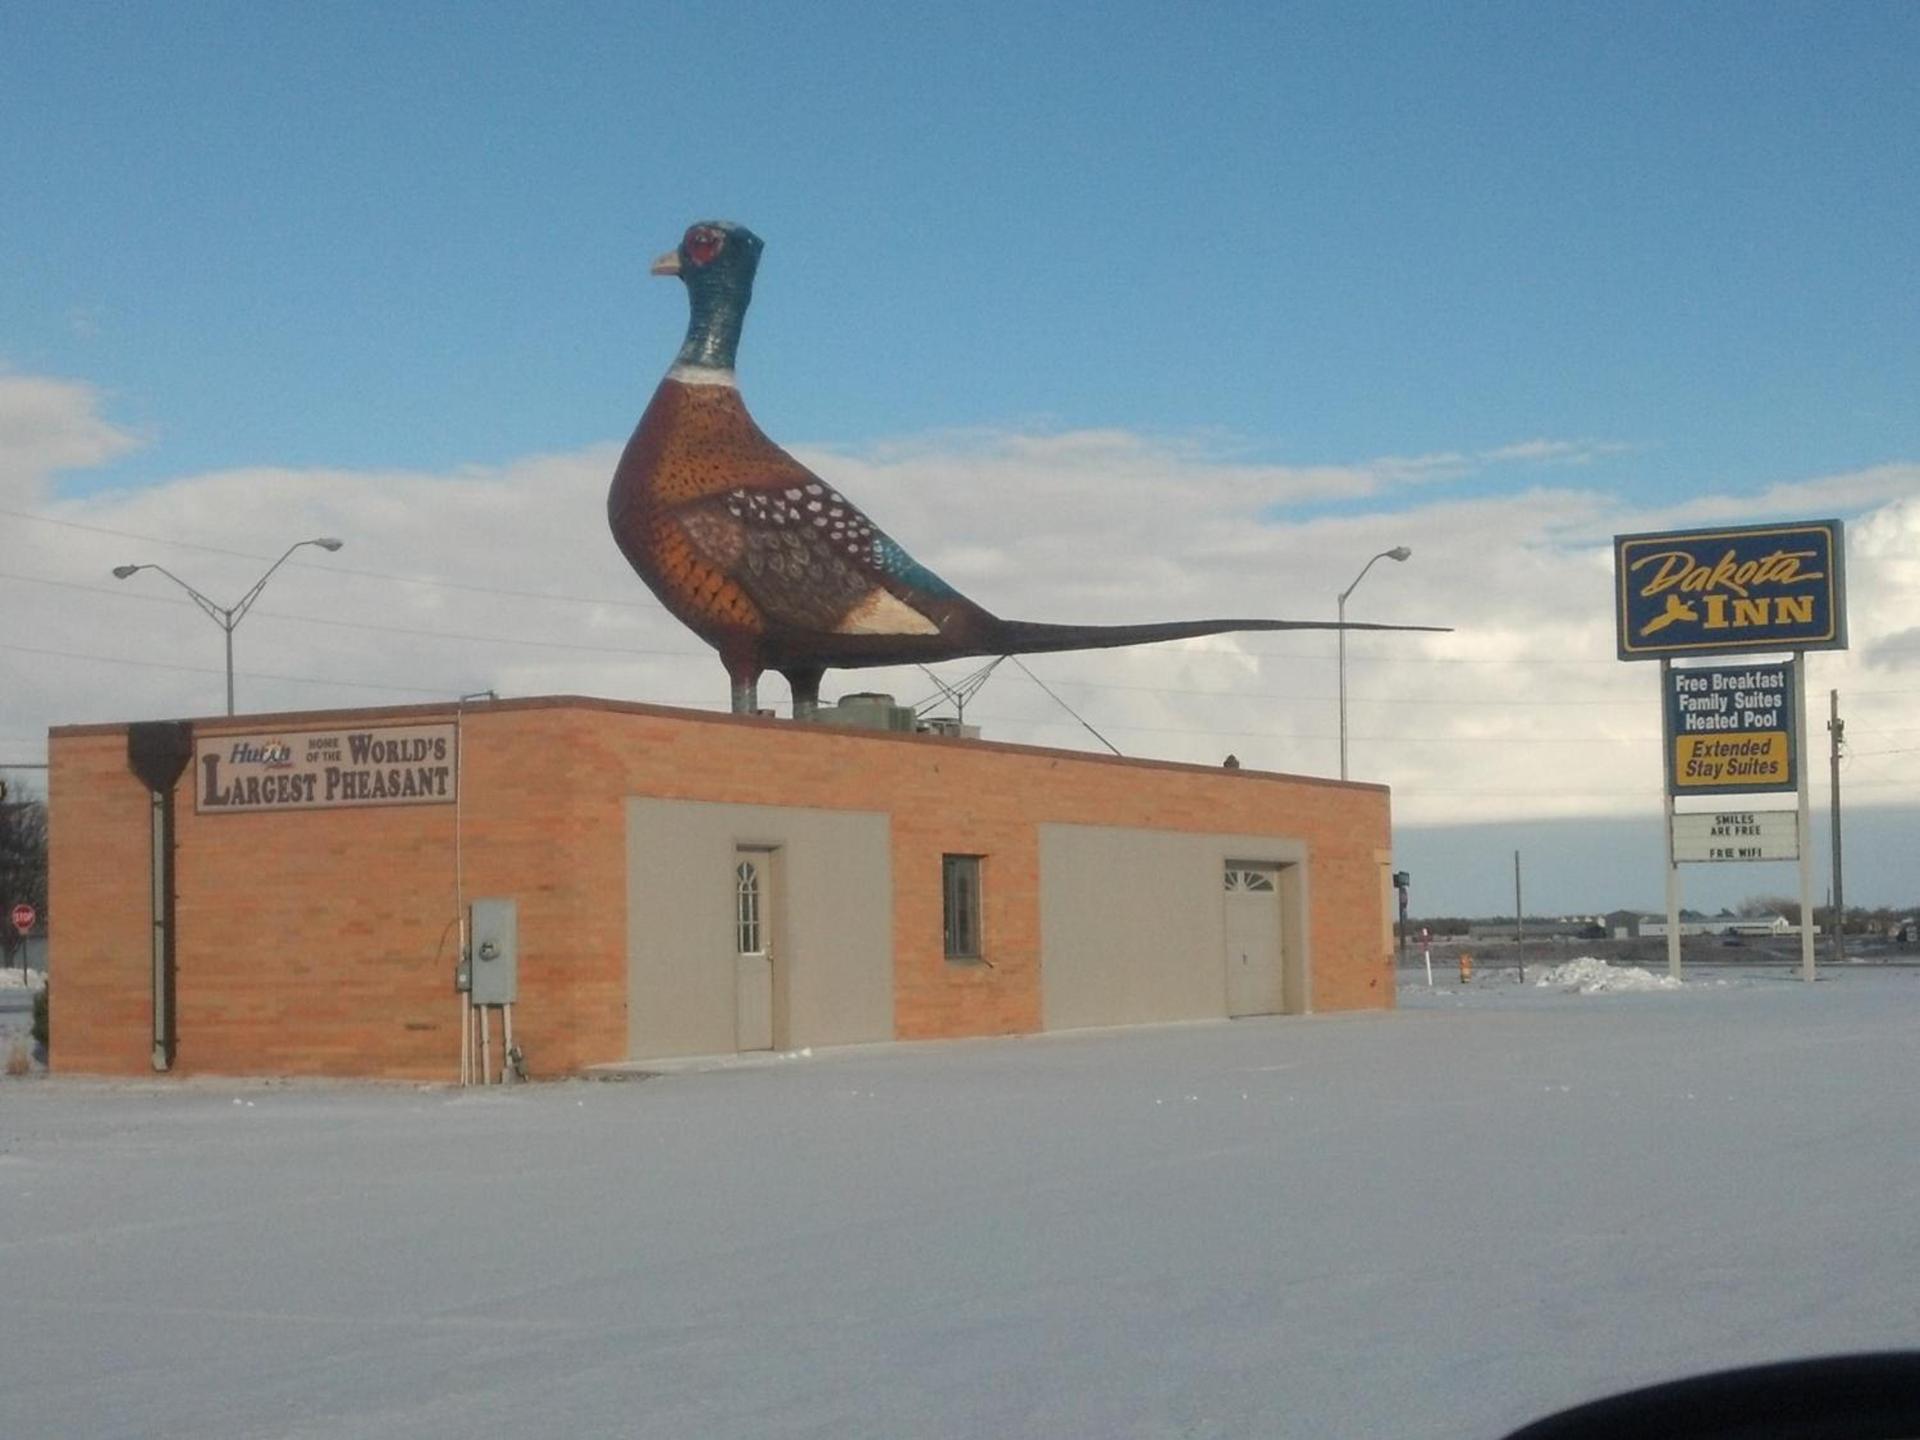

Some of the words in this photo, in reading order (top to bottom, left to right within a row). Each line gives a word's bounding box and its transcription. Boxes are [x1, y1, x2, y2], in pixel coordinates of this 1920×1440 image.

[1631, 549, 1823, 597] Dakota
[1703, 595, 1815, 629] INN
[1675, 675, 1708, 692] Free
[1712, 671, 1784, 690] Breakfast
[1679, 693, 1728, 712] Family
[1734, 691, 1782, 708] Suites
[1686, 713, 1738, 731] Heated
[1744, 710, 1777, 728] Pool
[308, 738, 340, 749] HOME
[347, 733, 446, 765] WORLD'S
[1692, 738, 1772, 759] Extended
[306, 752, 320, 763] OF
[322, 751, 342, 762] THE
[1686, 759, 1723, 780] Stay
[1726, 757, 1779, 776] Suites
[202, 753, 317, 806] LARGEST
[324, 766, 449, 801] PHEASANT
[1715, 815, 1754, 825] SMILES
[1710, 827, 1731, 836] ARE
[1735, 826, 1761, 836] FREE
[1709, 849, 1735, 859] FREE
[1739, 848, 1762, 858] WIFI
